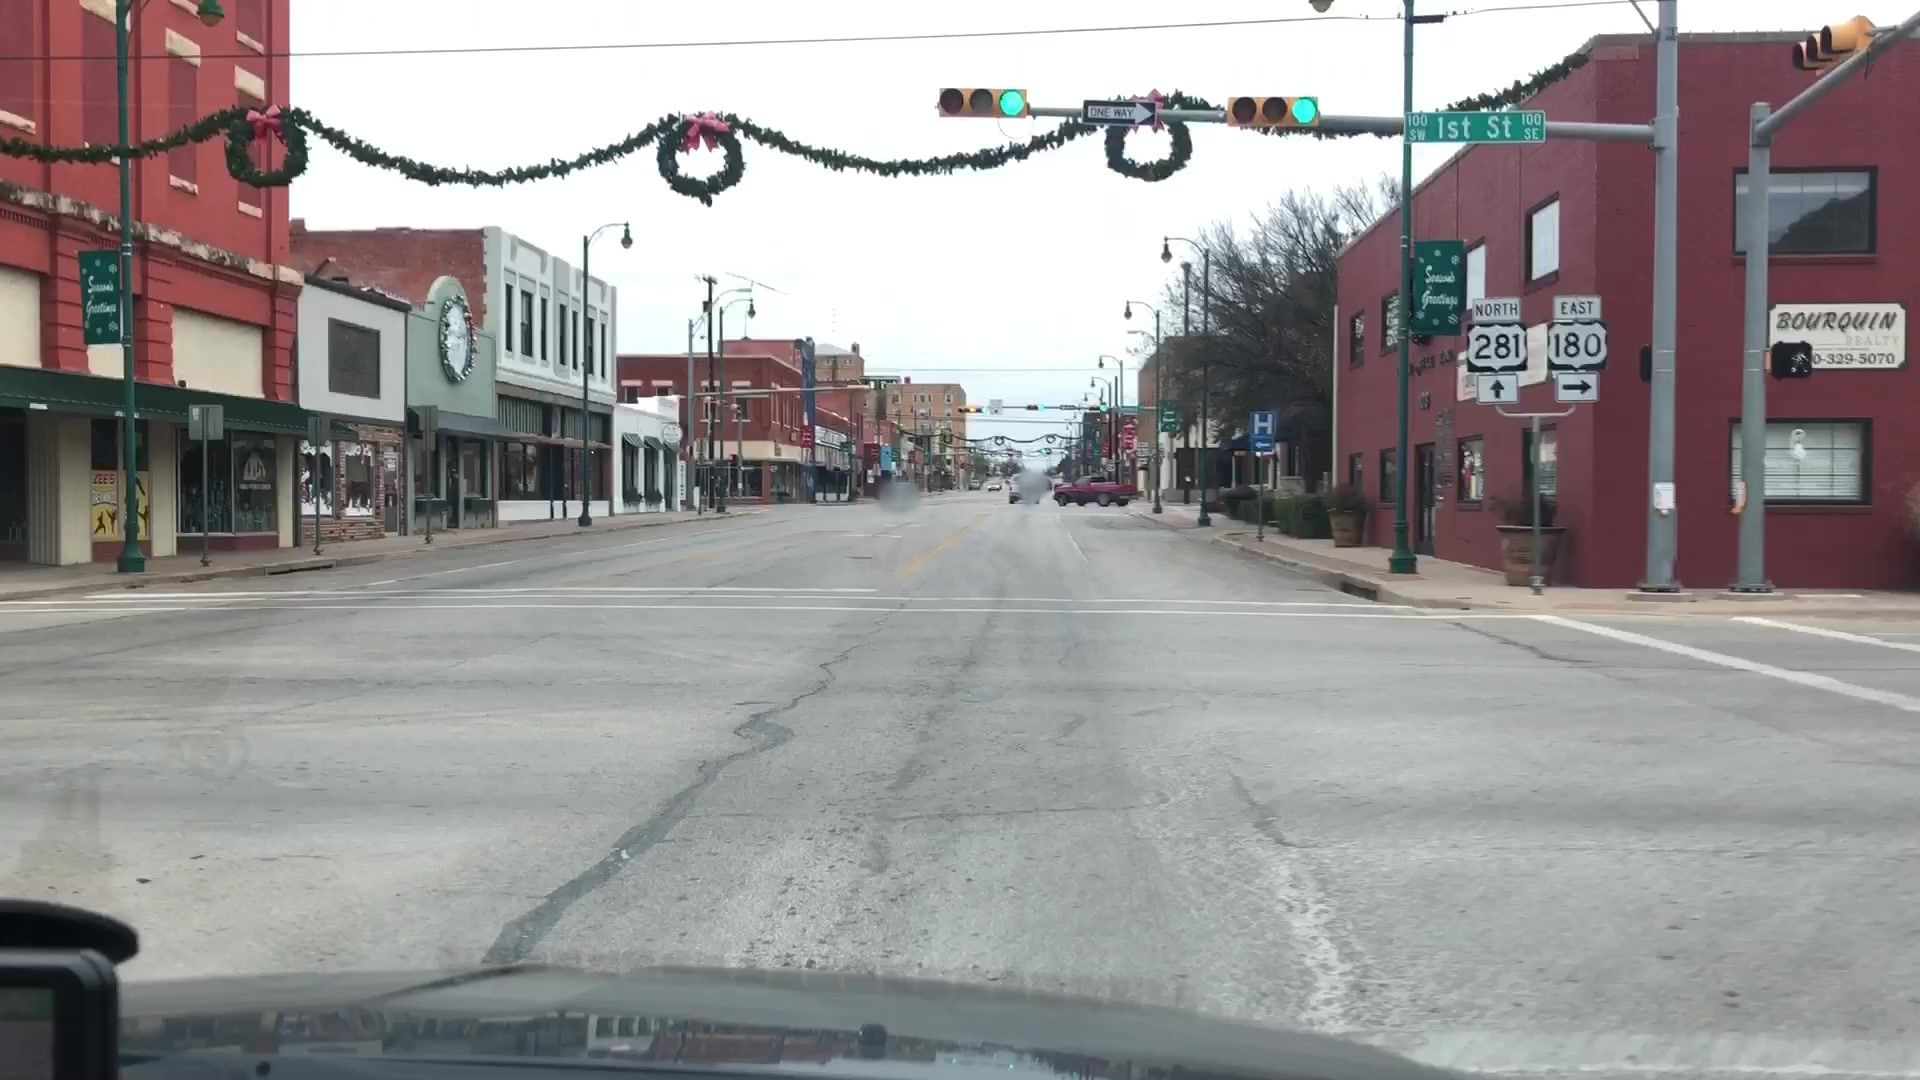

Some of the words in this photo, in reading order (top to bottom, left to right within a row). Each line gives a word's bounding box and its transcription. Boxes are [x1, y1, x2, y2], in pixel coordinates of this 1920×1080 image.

[1090, 107, 1112, 118] ONE
[1114, 107, 1134, 118] WAY
[1522, 113, 1542, 126] 100
[1408, 114, 1428, 127] 100
[1437, 116, 1471, 139] 1st
[1487, 116, 1512, 139] St
[1410, 129, 1427, 141] SW
[1524, 127, 1540, 140] SE
[86, 299, 117, 320] Greetings
[1475, 303, 1519, 317] NORTH
[1560, 301, 1594, 316] EAST
[1776, 311, 1898, 332] BOURQUIN
[1474, 333, 1520, 360] 281
[1554, 332, 1602, 358] 180
[1254, 413, 1273, 434] H
